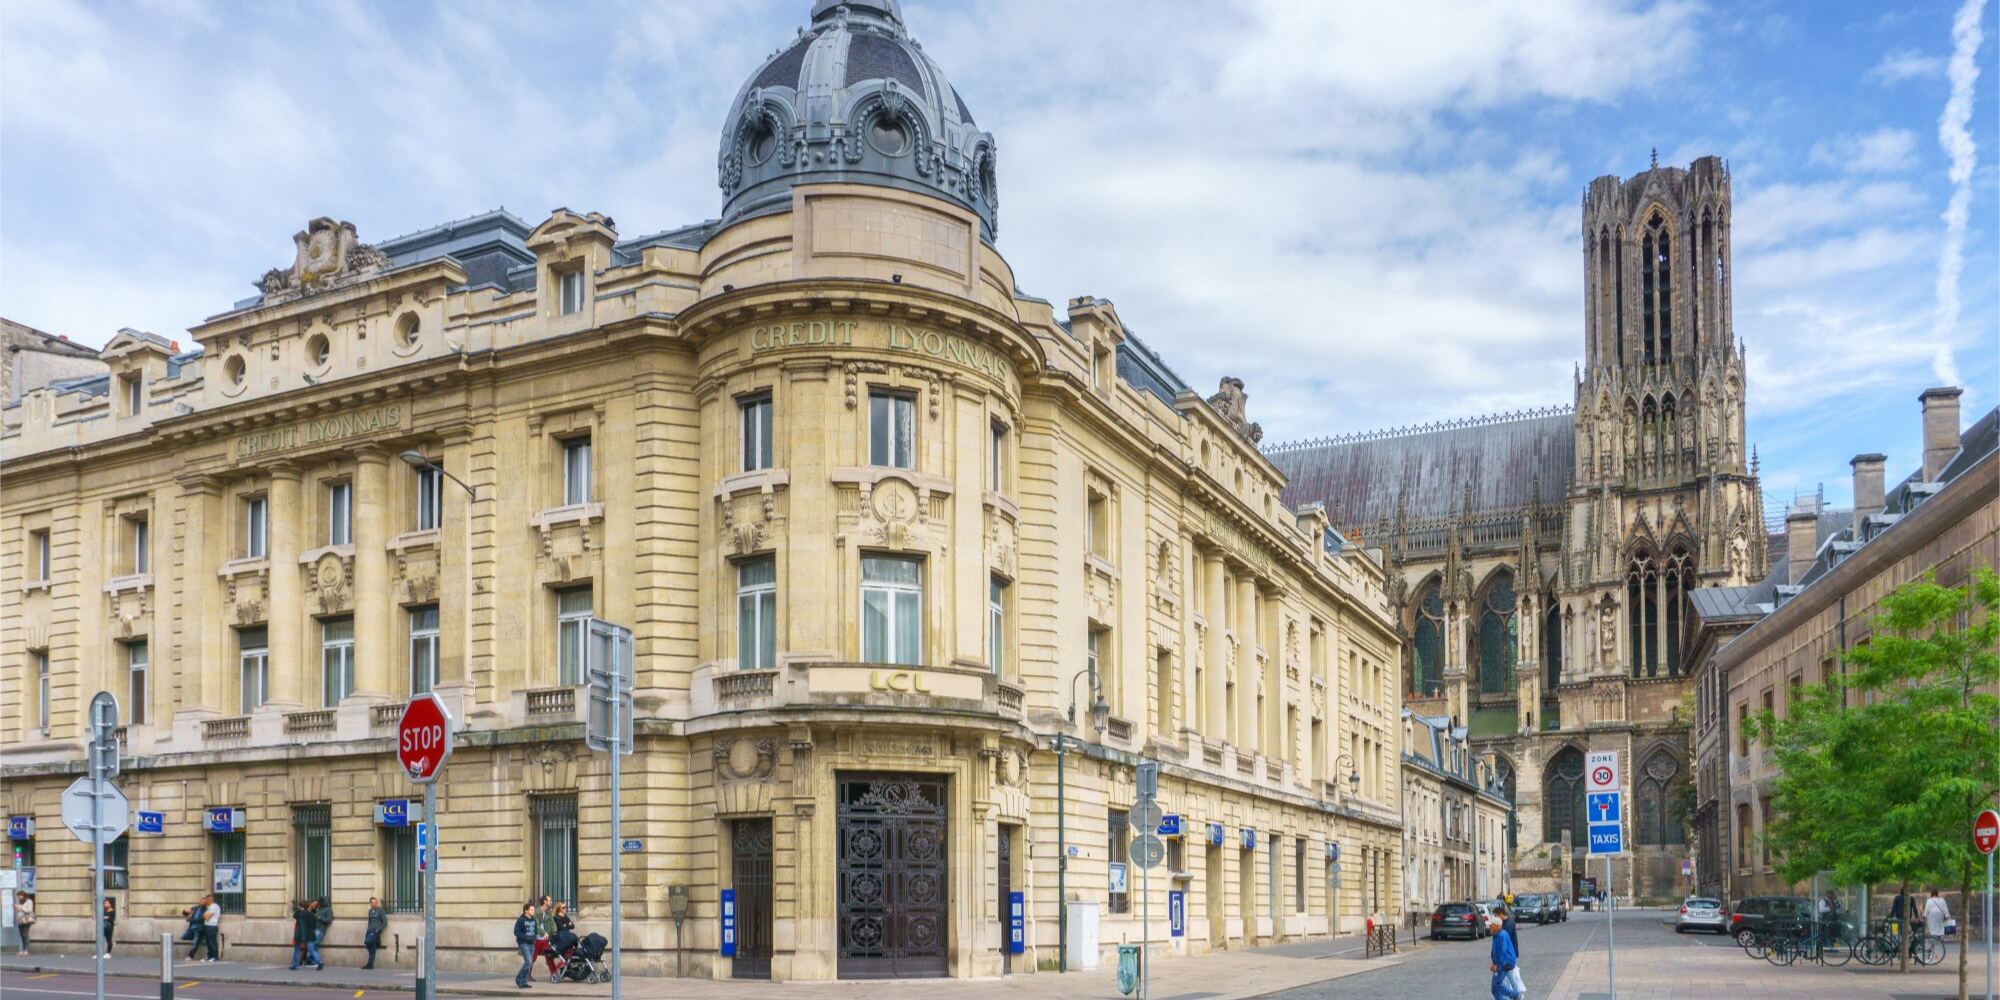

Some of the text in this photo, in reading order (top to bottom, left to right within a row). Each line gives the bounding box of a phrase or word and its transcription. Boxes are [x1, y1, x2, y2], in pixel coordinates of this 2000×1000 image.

[751, 321, 1008, 383] CREDIT LYONNAIS
[236, 405, 400, 457] CREDIT LYONNAIS
[870, 670, 931, 693] LCL
[403, 725, 442, 752] STOP
[1591, 755, 1613, 763] ZONE
[1597, 771, 1609, 780] 30
[383, 805, 404, 814] LCL
[140, 815, 159, 824] LCL
[211, 813, 230, 822] LCL
[9, 821, 25, 830] LCL
[1592, 834, 1618, 844] TAXIS
